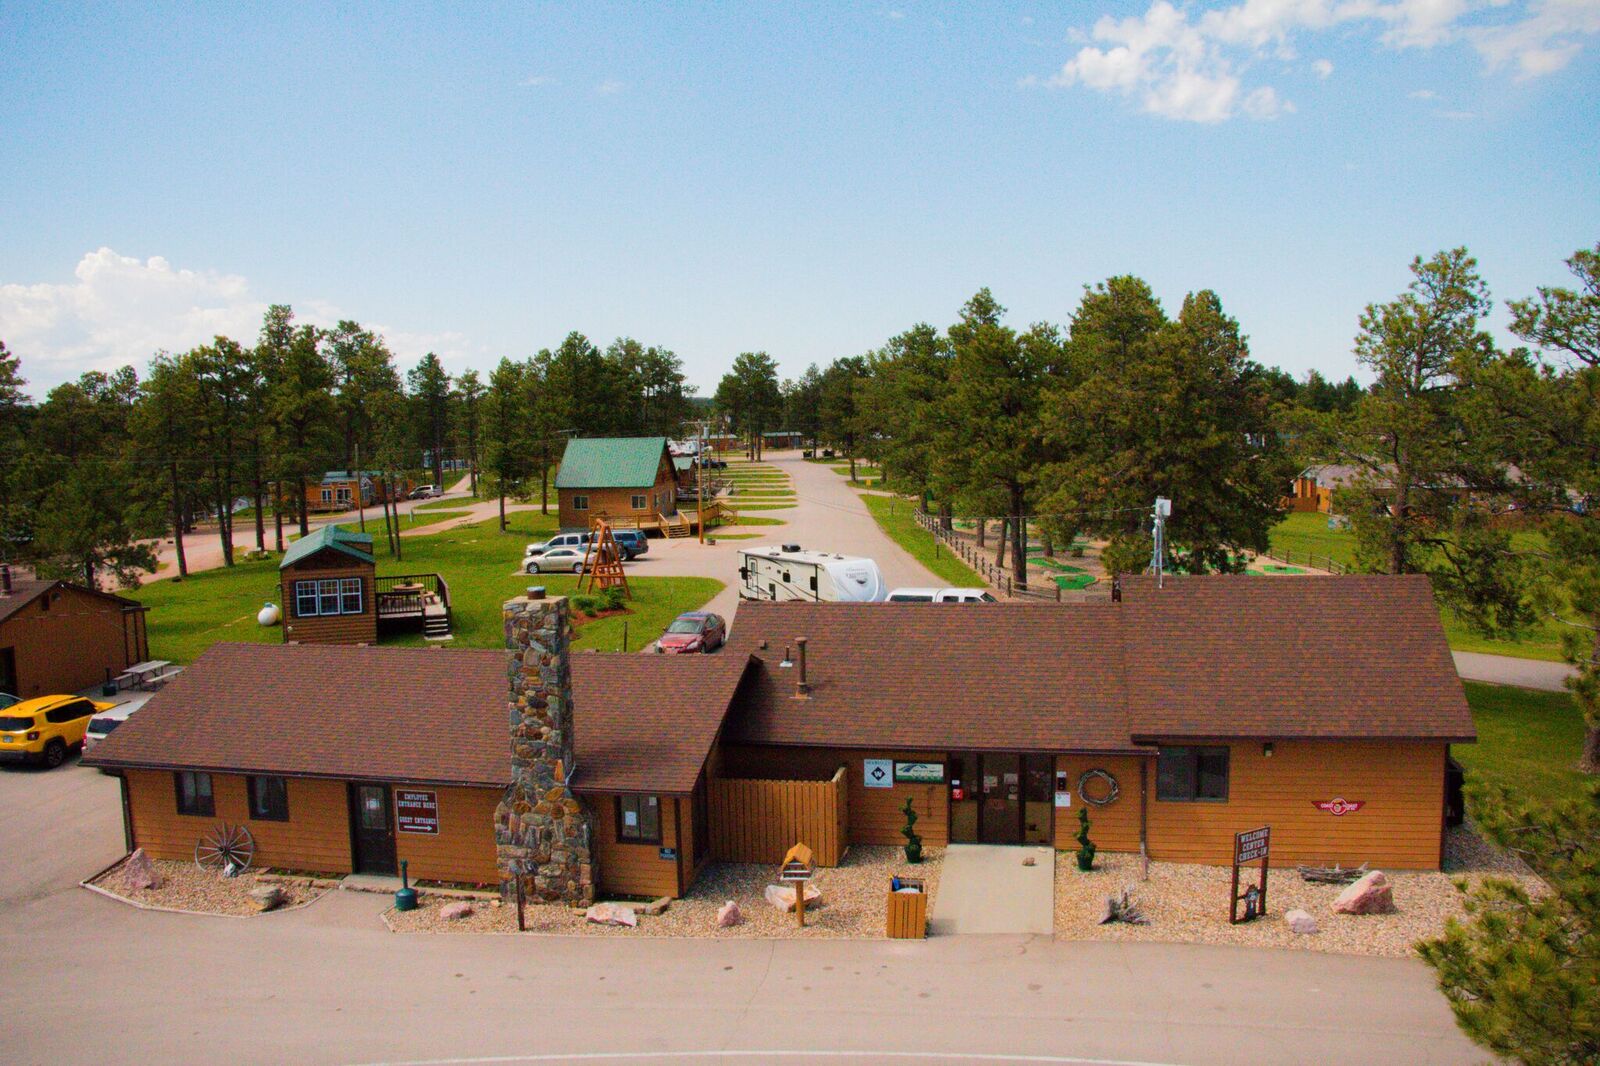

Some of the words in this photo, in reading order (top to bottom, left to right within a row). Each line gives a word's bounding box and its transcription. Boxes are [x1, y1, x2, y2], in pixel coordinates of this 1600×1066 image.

[1241, 829, 1269, 843] WELCOME
[1242, 839, 1265, 851] CENTER
[1239, 847, 1267, 861] CHECK-IN
